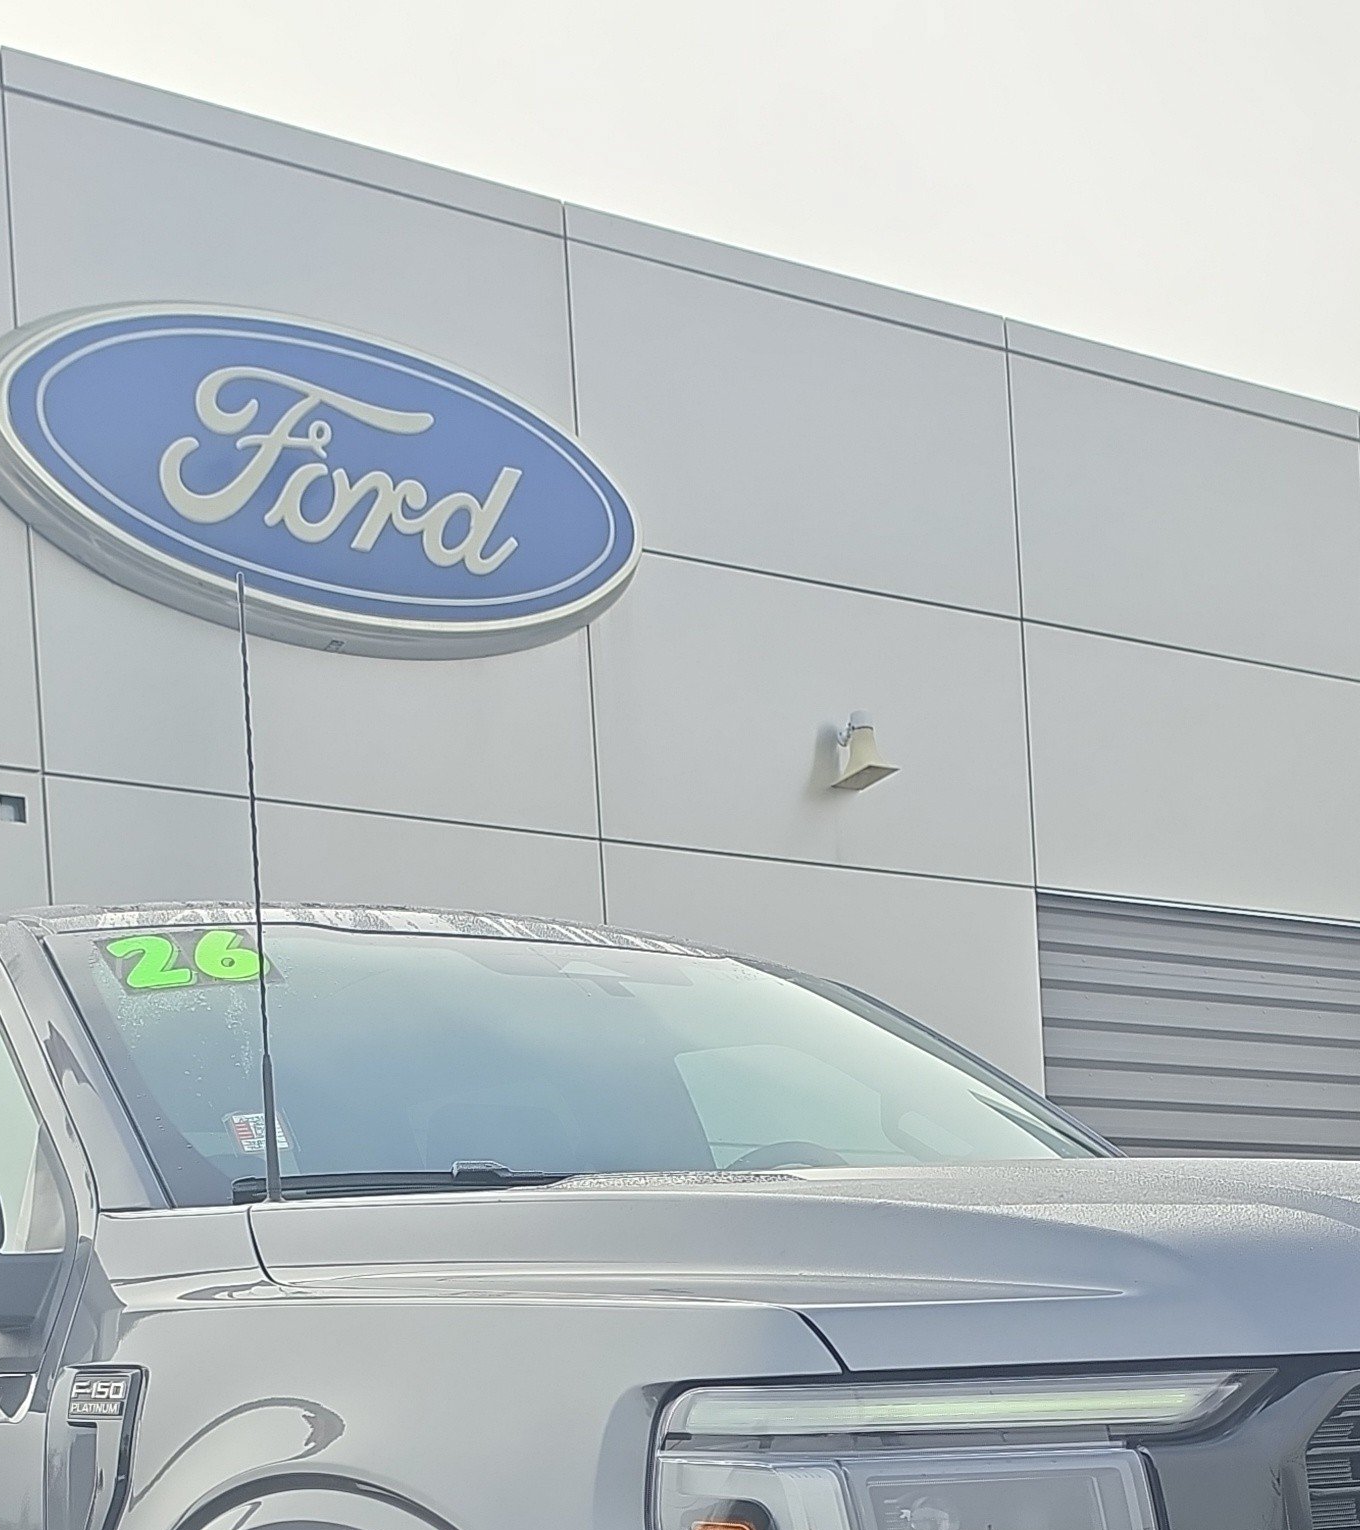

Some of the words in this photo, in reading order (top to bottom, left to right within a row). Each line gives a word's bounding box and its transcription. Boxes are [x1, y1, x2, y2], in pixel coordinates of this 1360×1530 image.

[159, 366, 522, 575] Ford
[106, 930, 271, 989] 26
[70, 1403, 119, 1413] PLATINUM
[71, 1380, 127, 1399] F-150
